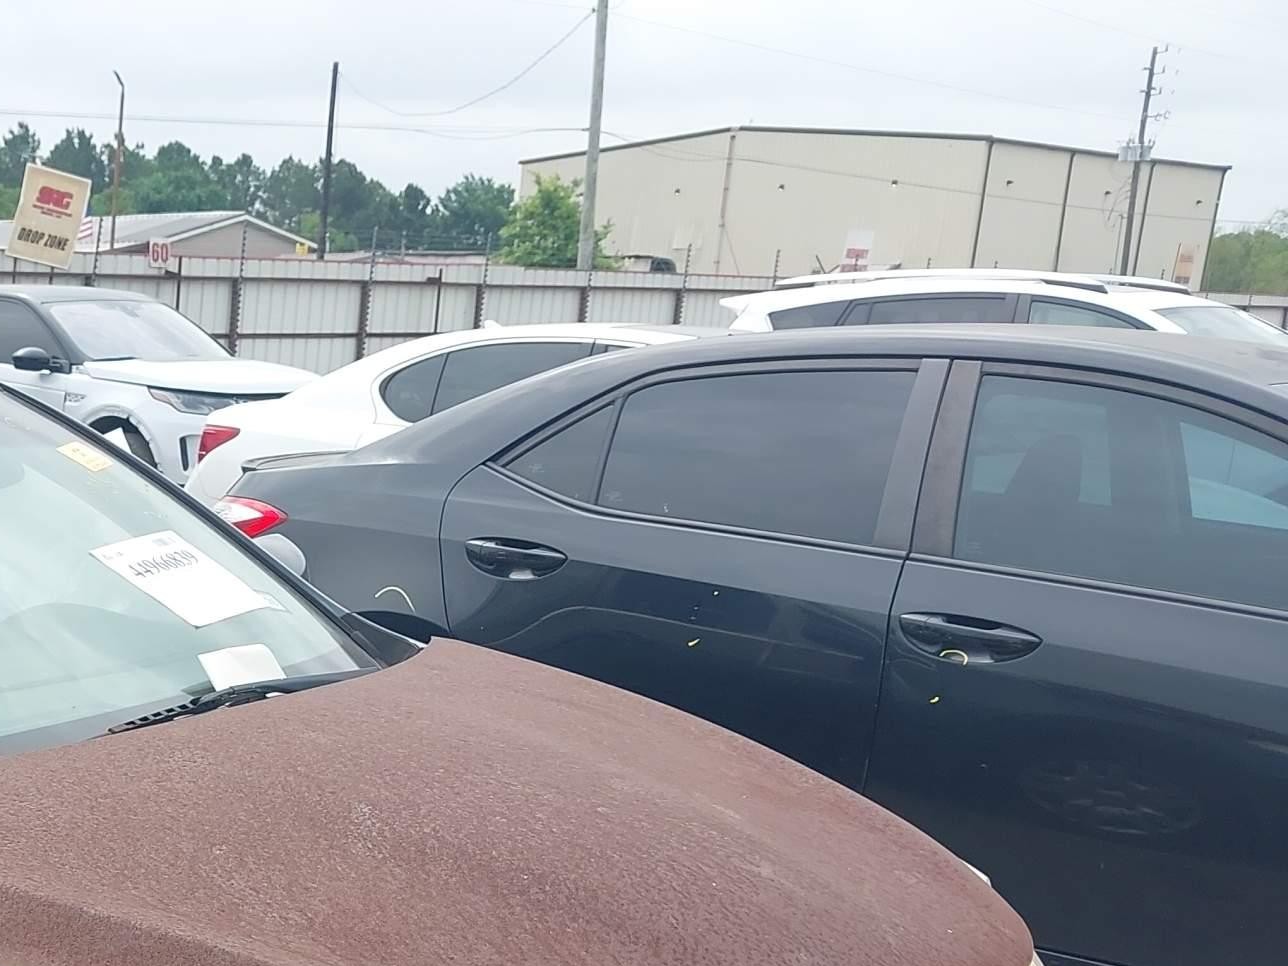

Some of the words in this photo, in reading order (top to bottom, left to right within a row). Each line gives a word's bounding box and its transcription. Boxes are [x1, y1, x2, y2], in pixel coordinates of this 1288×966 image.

[17, 227, 45, 245] DROP
[44, 233, 70, 251] ZONE
[151, 242, 169, 263] 60
[128, 549, 199, 578] 44966839
